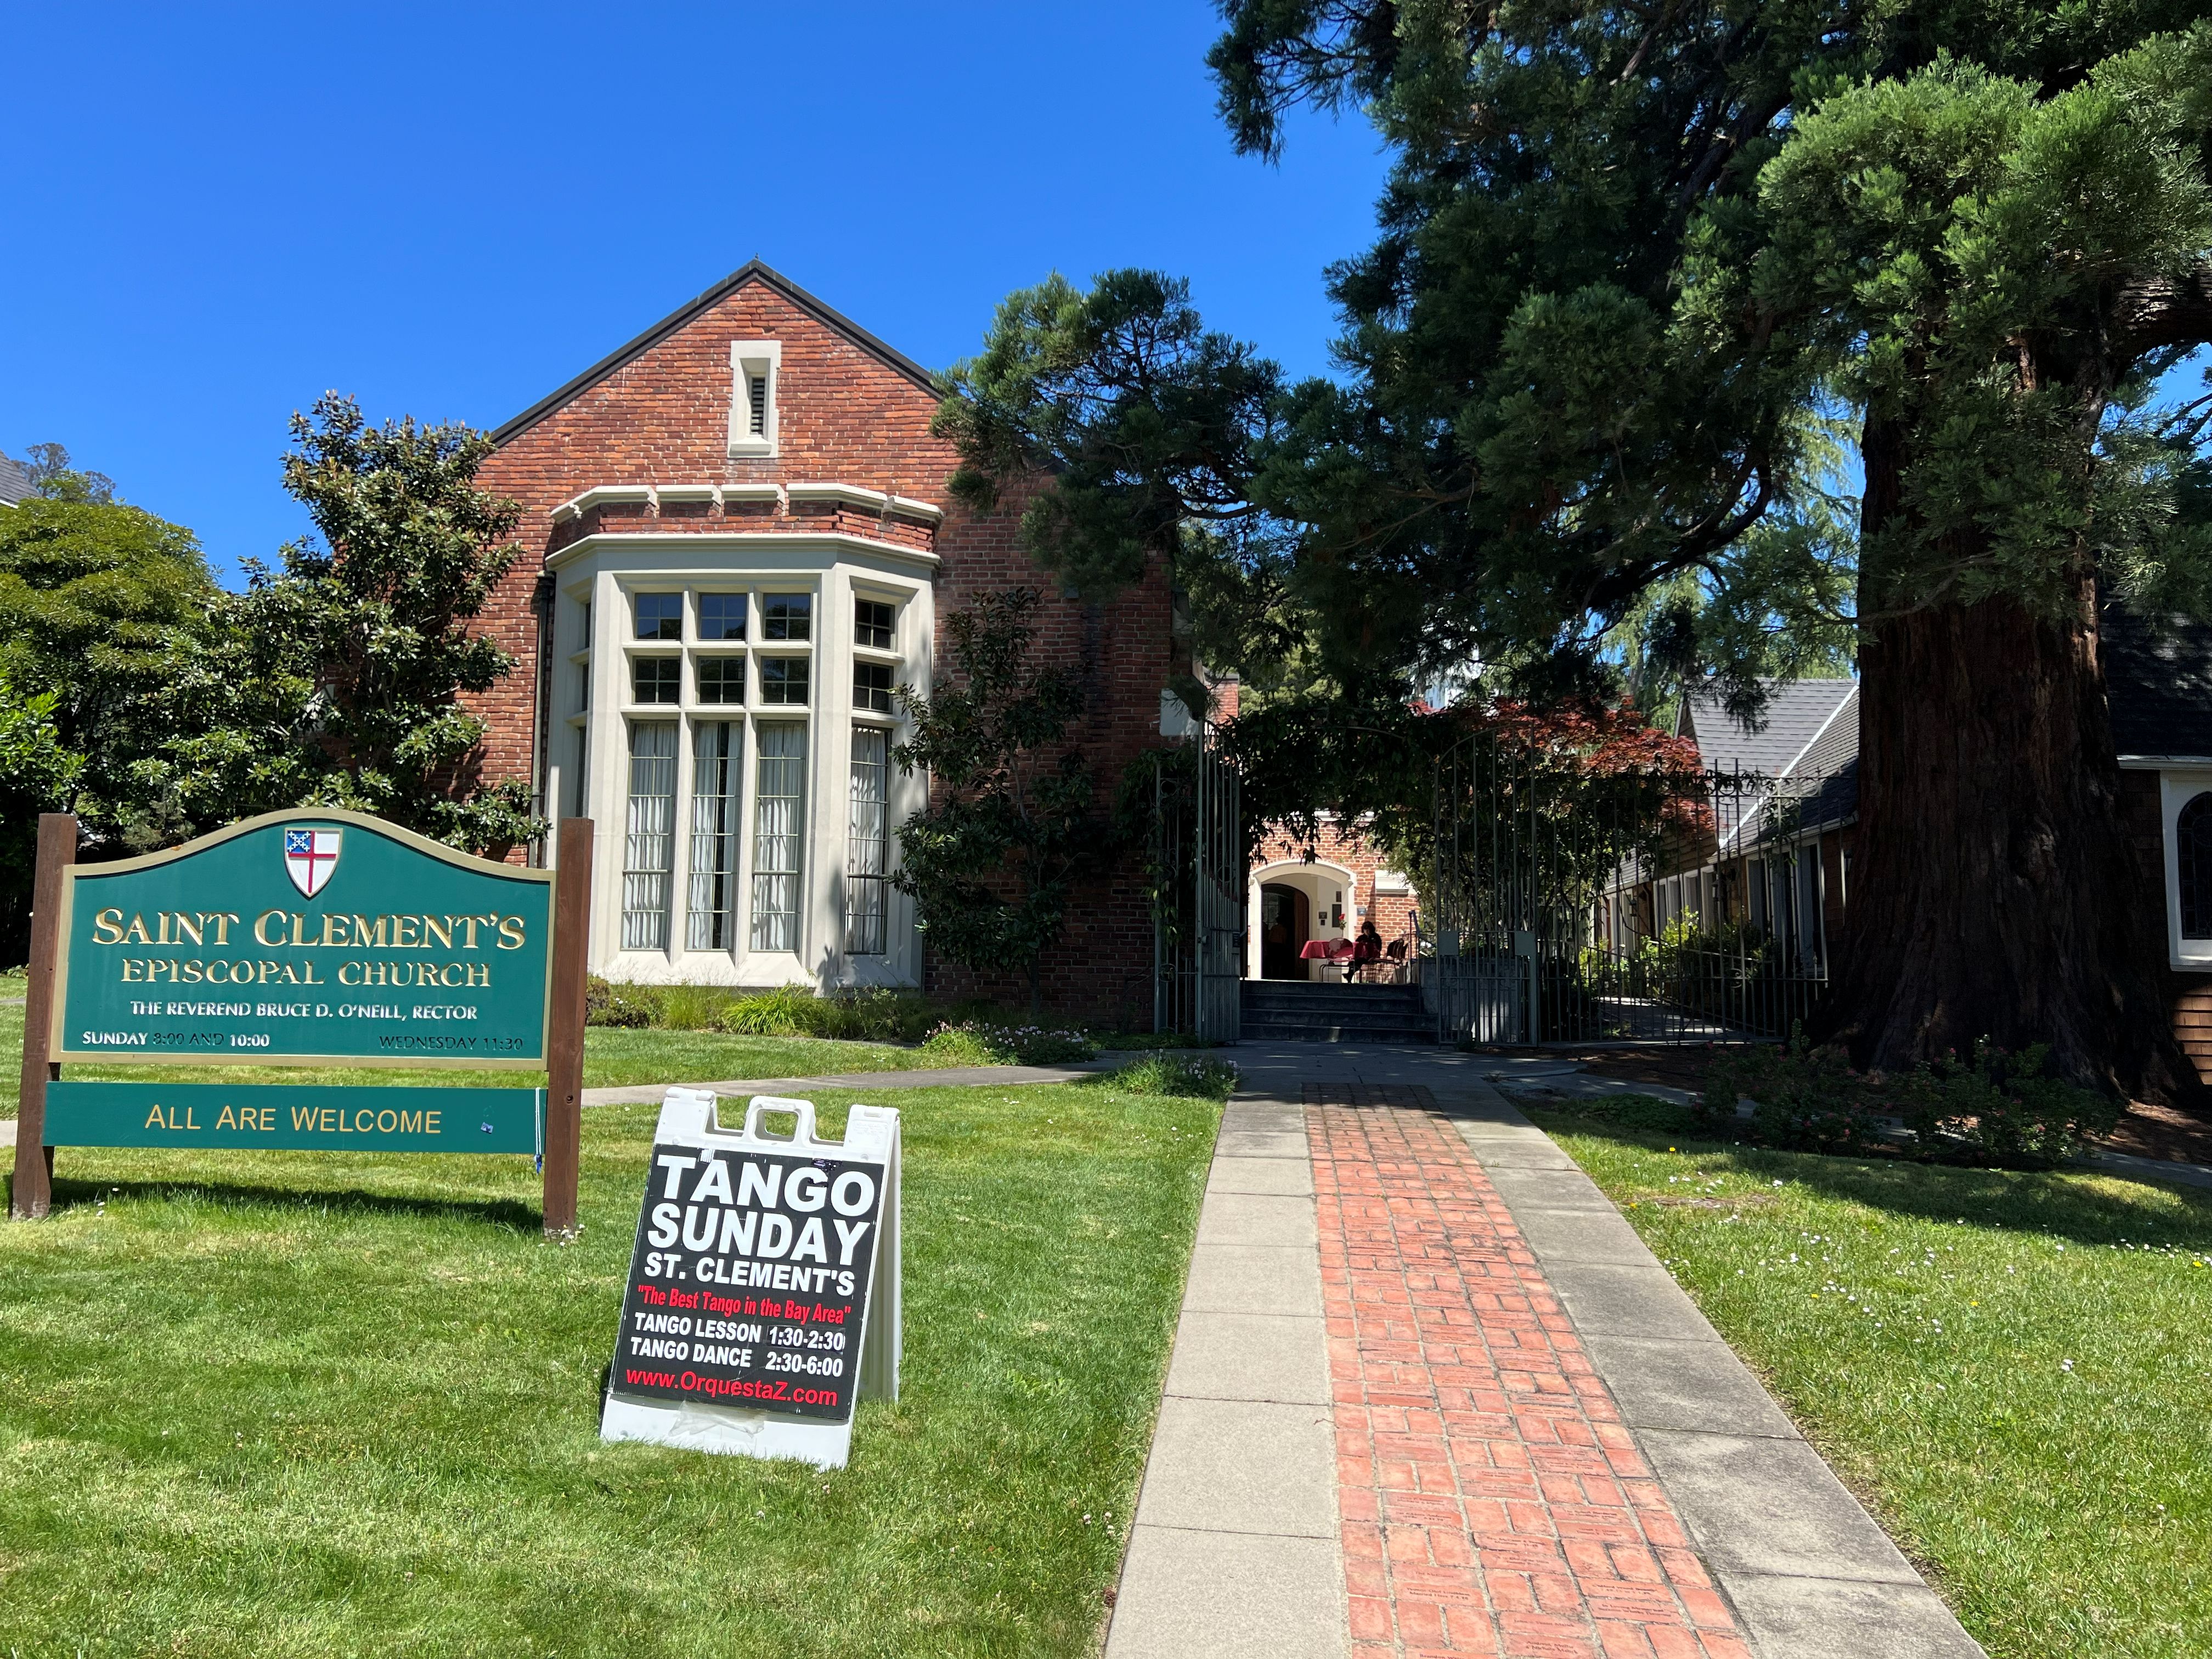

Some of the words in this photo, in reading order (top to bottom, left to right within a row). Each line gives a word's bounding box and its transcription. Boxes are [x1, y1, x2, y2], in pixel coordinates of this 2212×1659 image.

[92, 907, 239, 945] SAINT
[255, 908, 526, 950] CLEMENT'S
[121, 958, 326, 984] EPISCOPAL
[338, 961, 491, 987] CHURCH
[130, 1001, 162, 1015] THE
[167, 1001, 251, 1016] REVEREND
[256, 1002, 311, 1017] BRUCE
[316, 1004, 333, 1018] D.
[338, 1003, 407, 1021] O'NEILL,
[413, 1005, 477, 1019] RECTOR
[82, 1031, 148, 1045] SUNDAY
[153, 1032, 184, 1045] 8:00
[189, 1032, 224, 1046] AND
[229, 1034, 270, 1047] 10:00
[379, 1036, 476, 1050] WEDNESDAY
[483, 1038, 523, 1051] 11:30
[145, 1104, 201, 1130] ALL
[216, 1105, 275, 1131] ARE
[291, 1107, 441, 1133] WELCOME
[657, 1154, 874, 1217] TANGO
[647, 1203, 870, 1266] SUNDAY
[644, 1252, 686, 1279] ST.
[696, 1257, 855, 1296] CLEMENT'S
[638, 1285, 666, 1306] "The
[669, 1288, 699, 1309] Best
[703, 1291, 741, 1317] Tango
[744, 1296, 757, 1315] in
[760, 1298, 781, 1317] the
[785, 1300, 810, 1325] Bay
[812, 1303, 851, 1324] Area"
[635, 1312, 691, 1335] TANGO
[695, 1318, 761, 1343] LESSON
[769, 1326, 844, 1351] 1:30-2:30
[631, 1336, 689, 1361] TANGO
[692, 1344, 752, 1368] DANCE
[765, 1351, 843, 1377] 2:30-6:00
[627, 1369, 837, 1407] www.OrquestaZ.com
